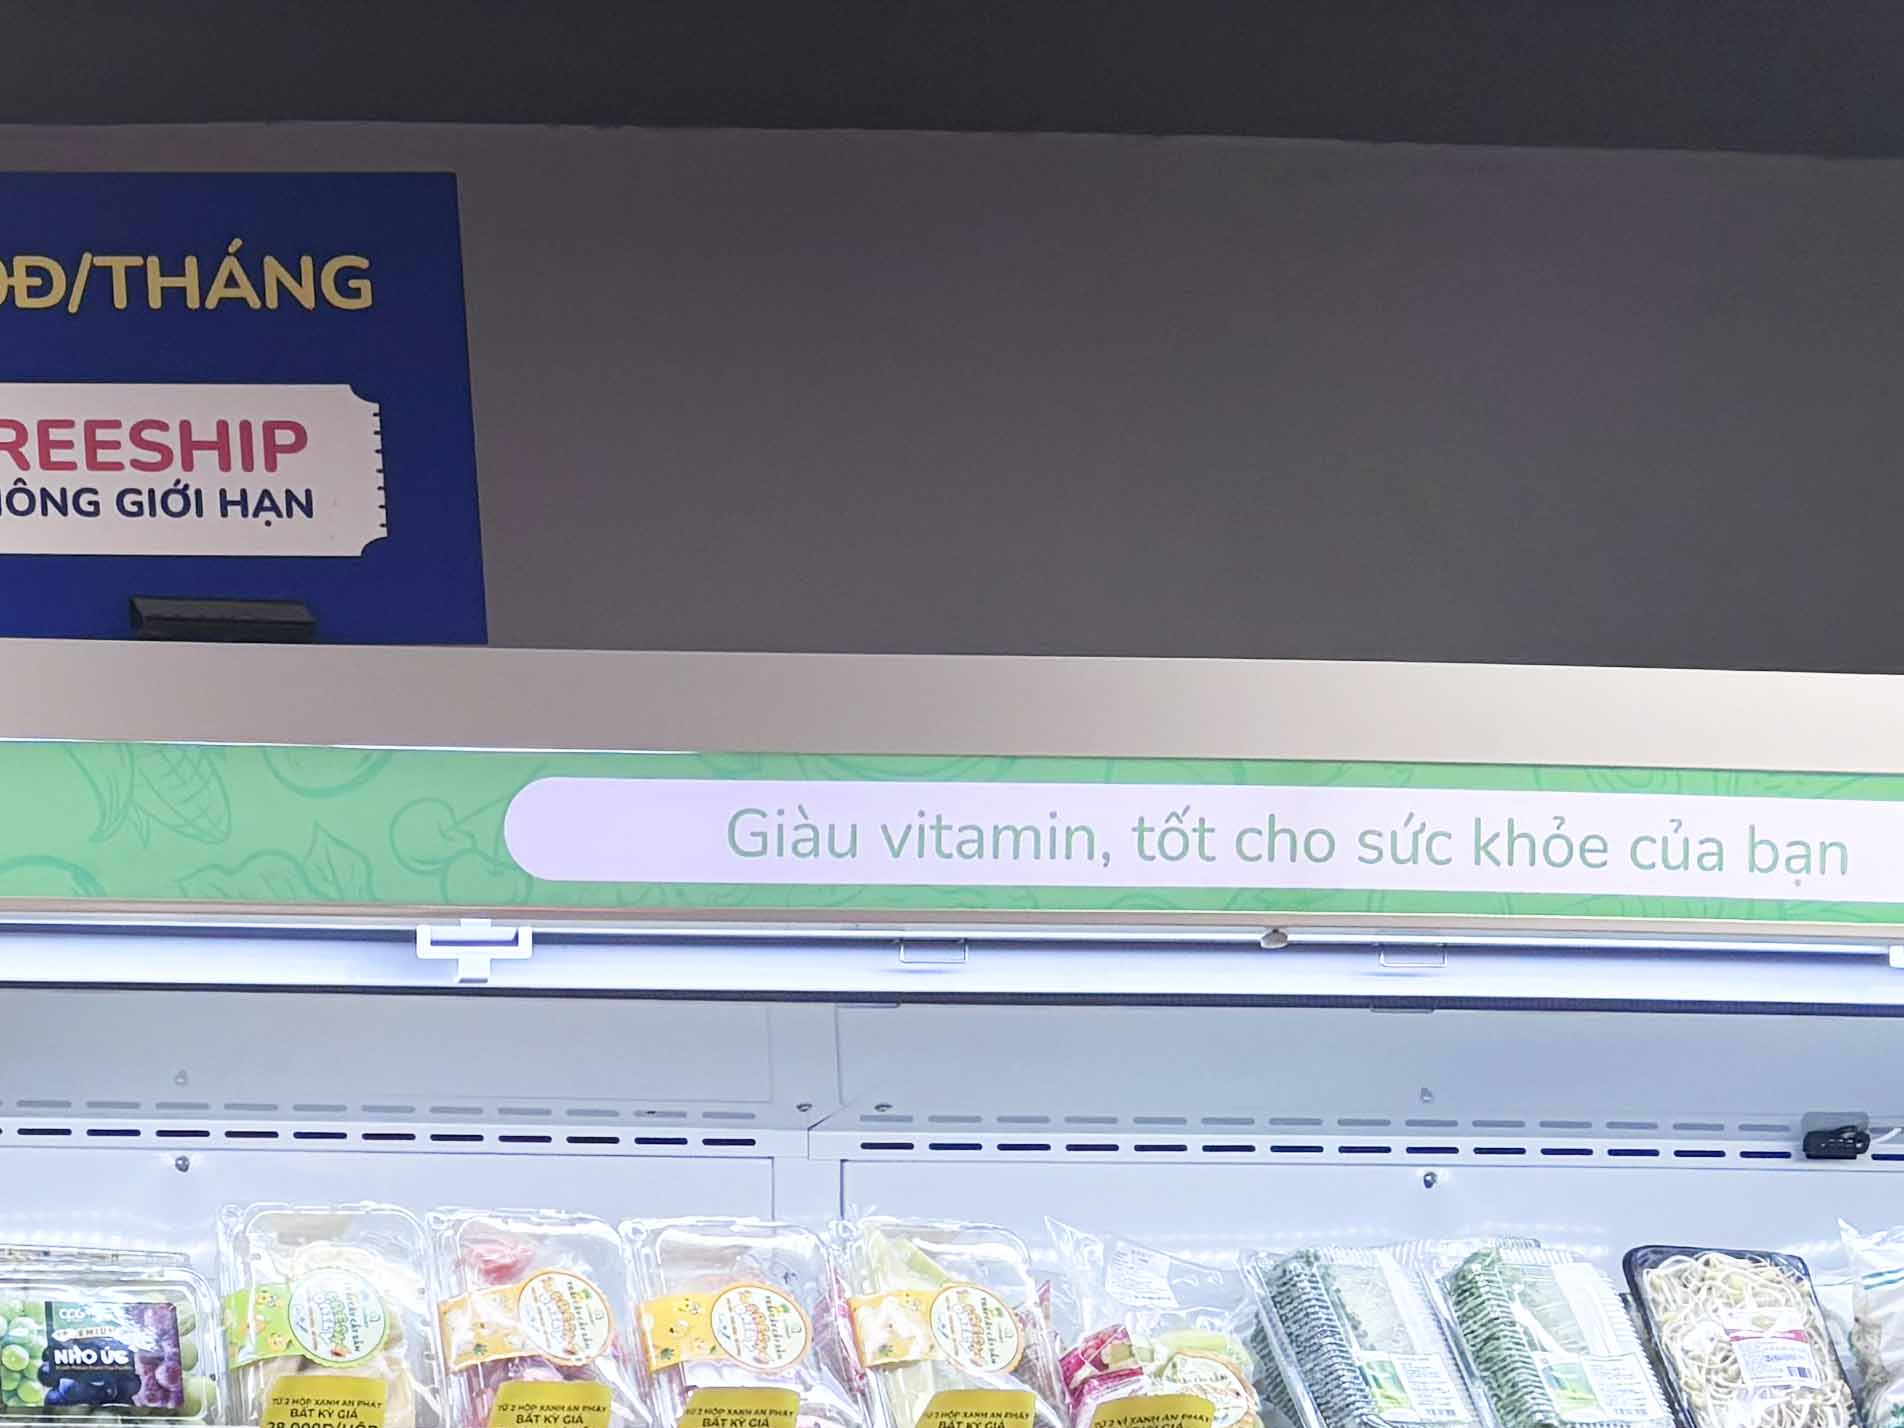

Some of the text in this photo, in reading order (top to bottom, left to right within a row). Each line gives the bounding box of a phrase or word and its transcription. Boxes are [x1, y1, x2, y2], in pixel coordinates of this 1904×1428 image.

[115, 478, 204, 519] GIỚI
[218, 486, 314, 527] HẠN
[727, 805, 1850, 887] Giàu vitamin, tốt cho sức khỏe của bạn
